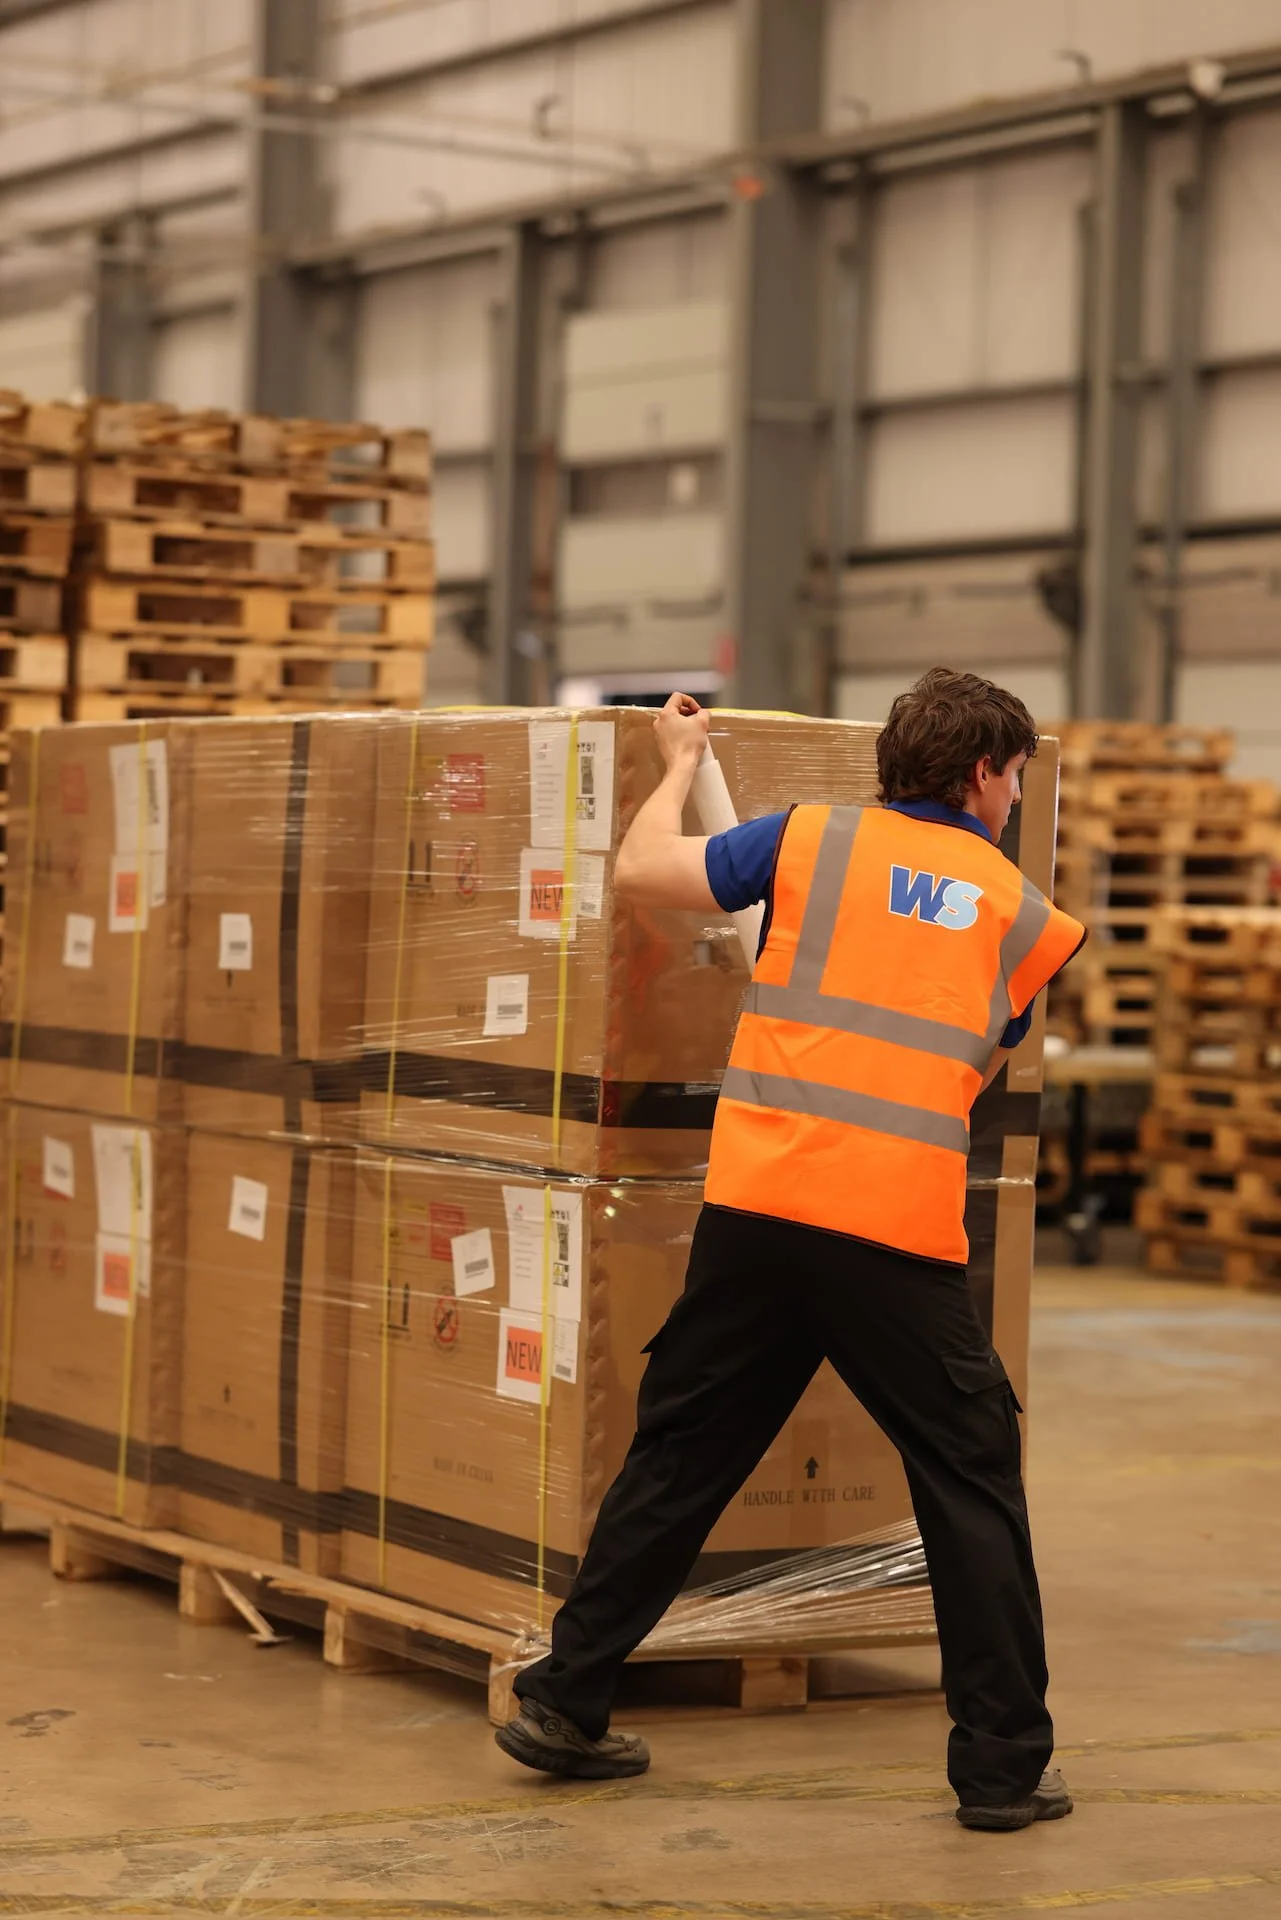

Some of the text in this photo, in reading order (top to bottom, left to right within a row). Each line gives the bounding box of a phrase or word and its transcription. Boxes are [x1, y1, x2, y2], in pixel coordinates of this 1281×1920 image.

[888, 864, 984, 930] WS
[507, 1340, 542, 1373] NEW
[743, 1485, 876, 1506] HANDLE WITH CARE
